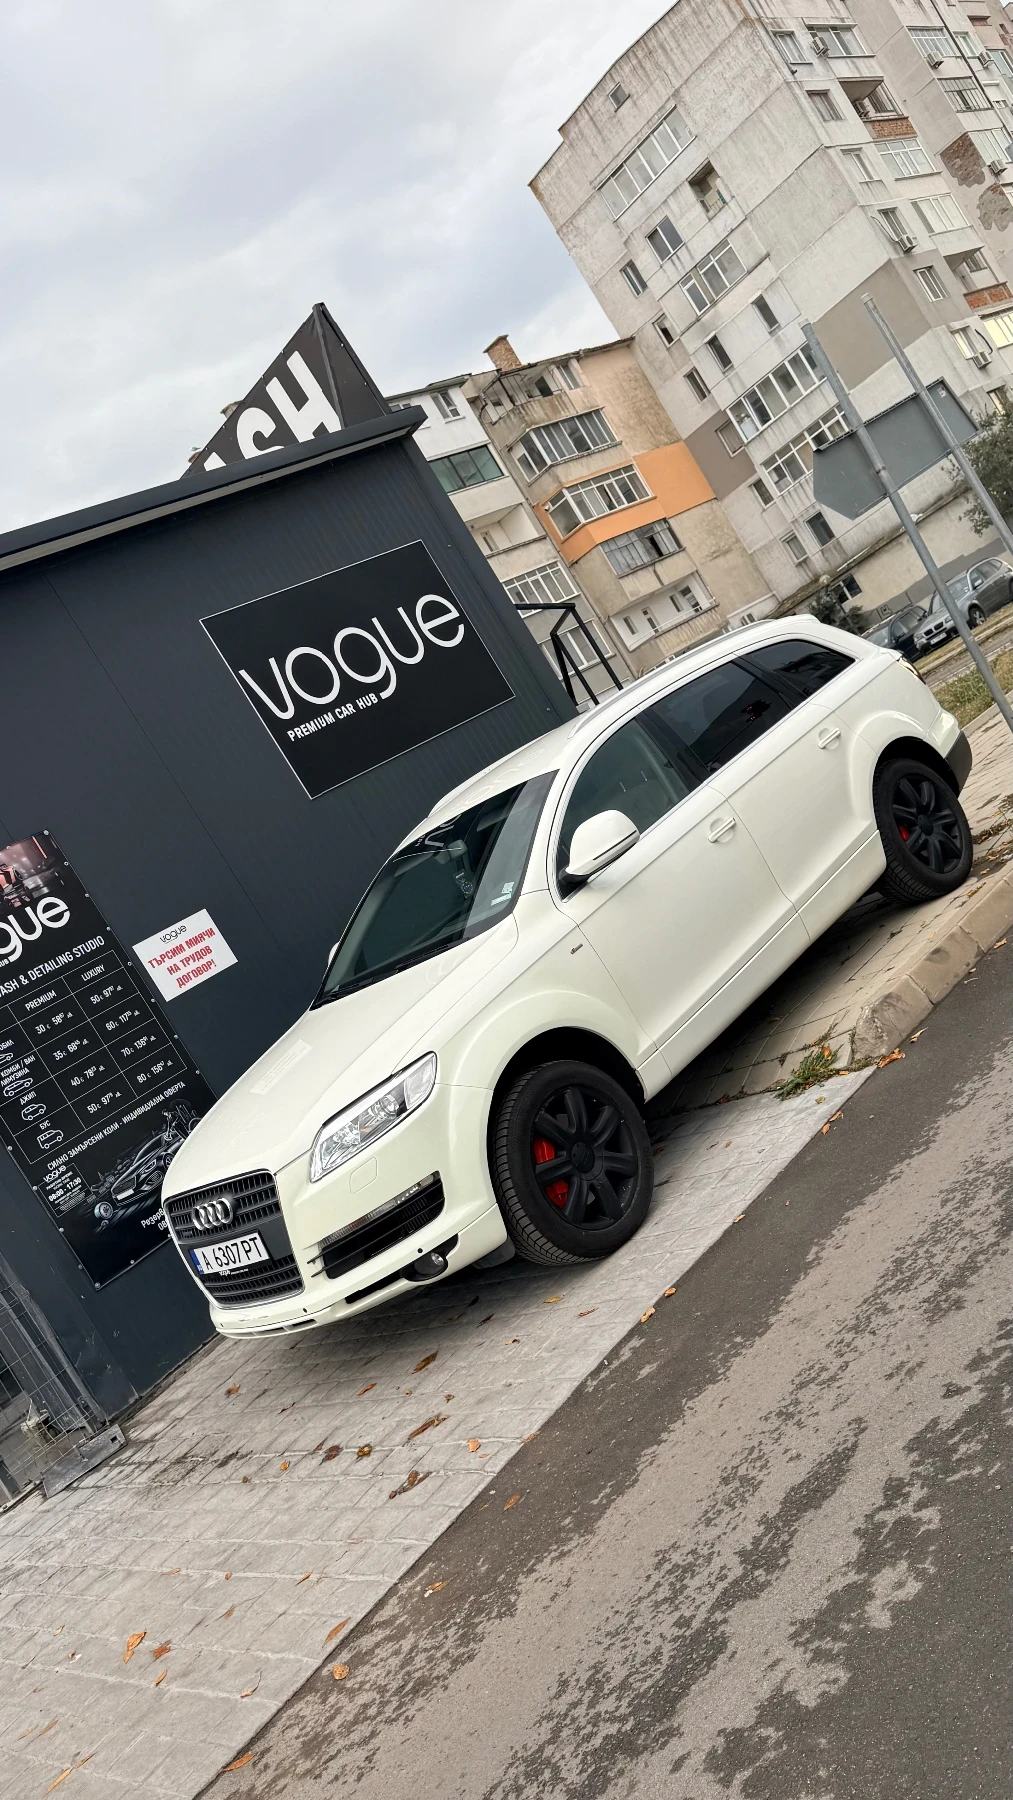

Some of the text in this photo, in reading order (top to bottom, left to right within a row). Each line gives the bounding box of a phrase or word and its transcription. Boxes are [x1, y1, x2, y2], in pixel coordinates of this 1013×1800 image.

[203, 350, 342, 472] SH
[238, 593, 465, 720] vogue
[287, 692, 379, 741] PREMIUM CAR HUB
[19, 974, 30, 985] &
[28, 951, 74, 981] DETAILING
[72, 935, 105, 958] STUDIO
[148, 927, 216, 969] ТЪРСИМ МИЯЧИ
[166, 945, 213, 976] НА ТРУДОВ
[81, 964, 105, 981] LUXURY
[176, 958, 217, 989] ДОГОВОР!
[25, 989, 57, 1011] PREMIUM
[35, 1023, 46, 1035] 30
[0, 1063, 21, 1078] КОМБИ
[23, 1055, 36, 1065] ВАН
[39, 1119, 51, 1130] БУС
[47, 1153, 69, 1171] СИЛНО
[67, 1132, 103, 1159] ЗАМЪРСЕНИ
[102, 1121, 120, 1138] КОЛИ
[121, 1093, 165, 1125] ИНДИВИДУАЛНА
[163, 1081, 186, 1098] ОФЕРТА
[201, 1236, 263, 1271] A 6307 PT
